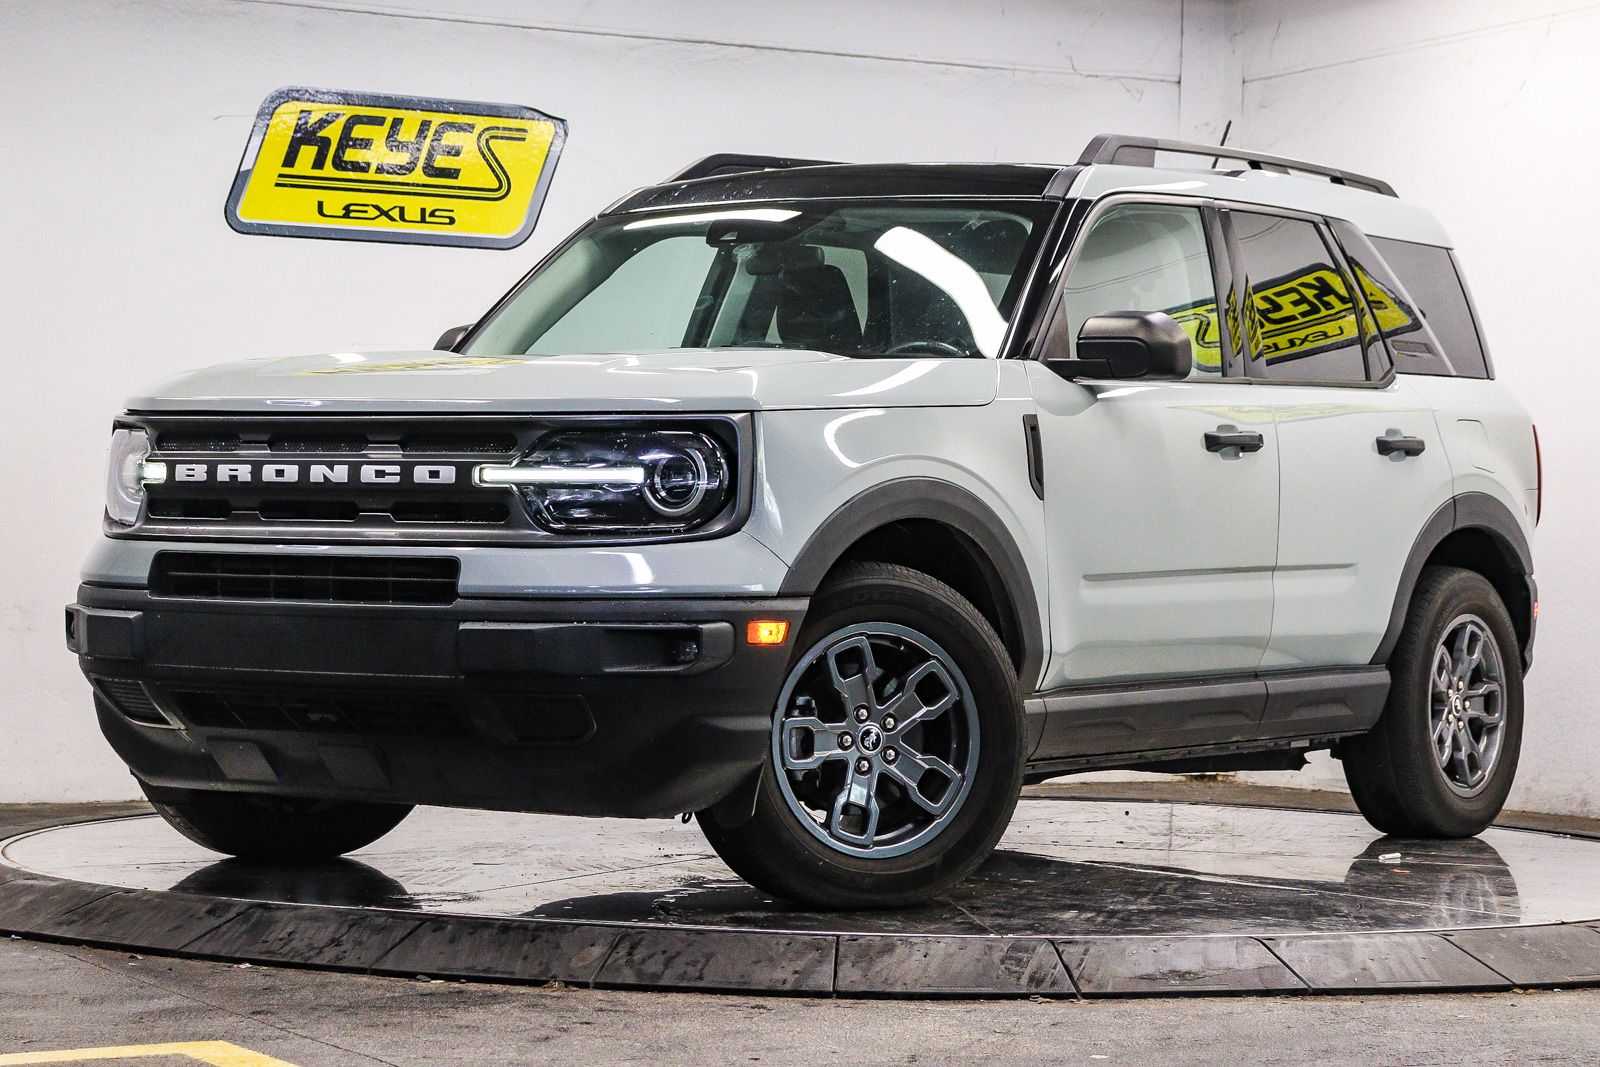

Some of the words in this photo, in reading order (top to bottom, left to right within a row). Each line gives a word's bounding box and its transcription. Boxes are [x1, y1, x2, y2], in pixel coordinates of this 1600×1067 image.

[281, 109, 528, 202] KEYES
[317, 200, 456, 226] LEXUS
[175, 463, 456, 484] BRONCO
